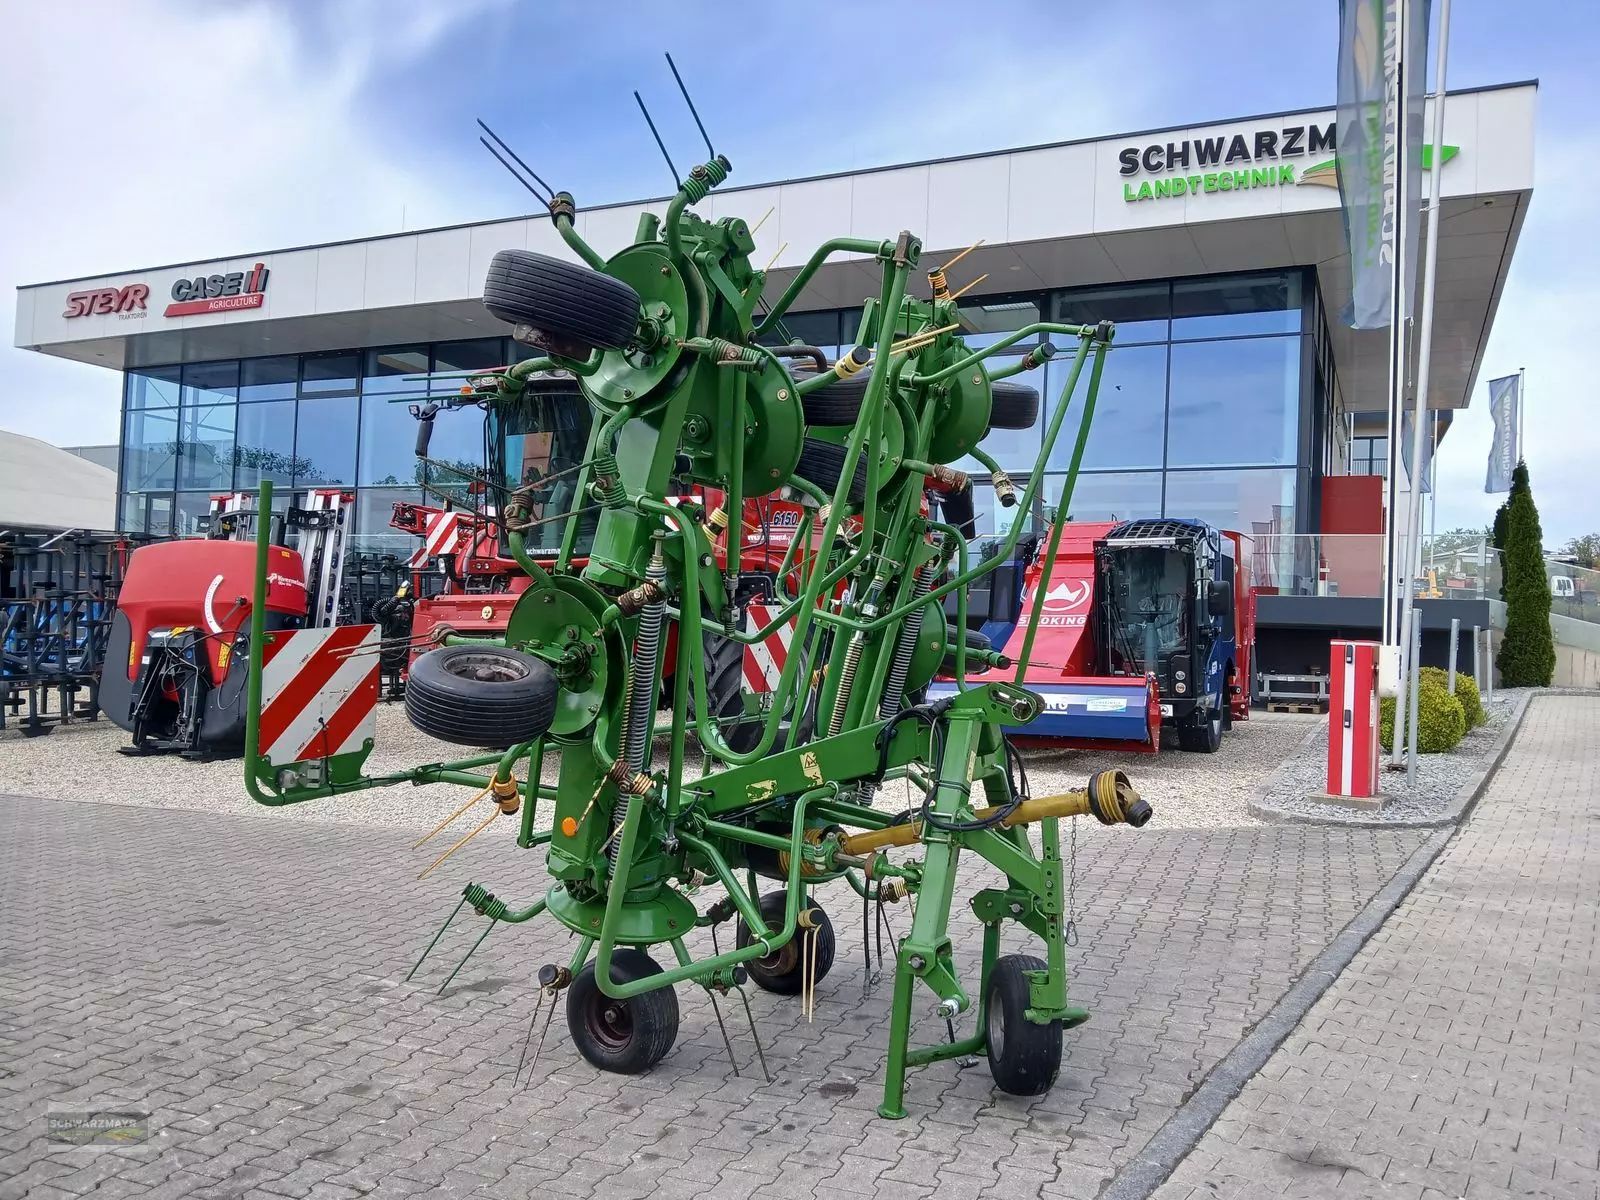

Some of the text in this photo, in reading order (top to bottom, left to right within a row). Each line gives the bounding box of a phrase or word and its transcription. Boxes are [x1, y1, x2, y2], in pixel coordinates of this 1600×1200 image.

[1124, 163, 1295, 202] LANDTECHNIK
[62, 283, 149, 318] STEYR
[208, 297, 259, 310] AGRICULTURE
[118, 311, 147, 320] TRAKTOREN
[773, 511, 798, 525] 6150
